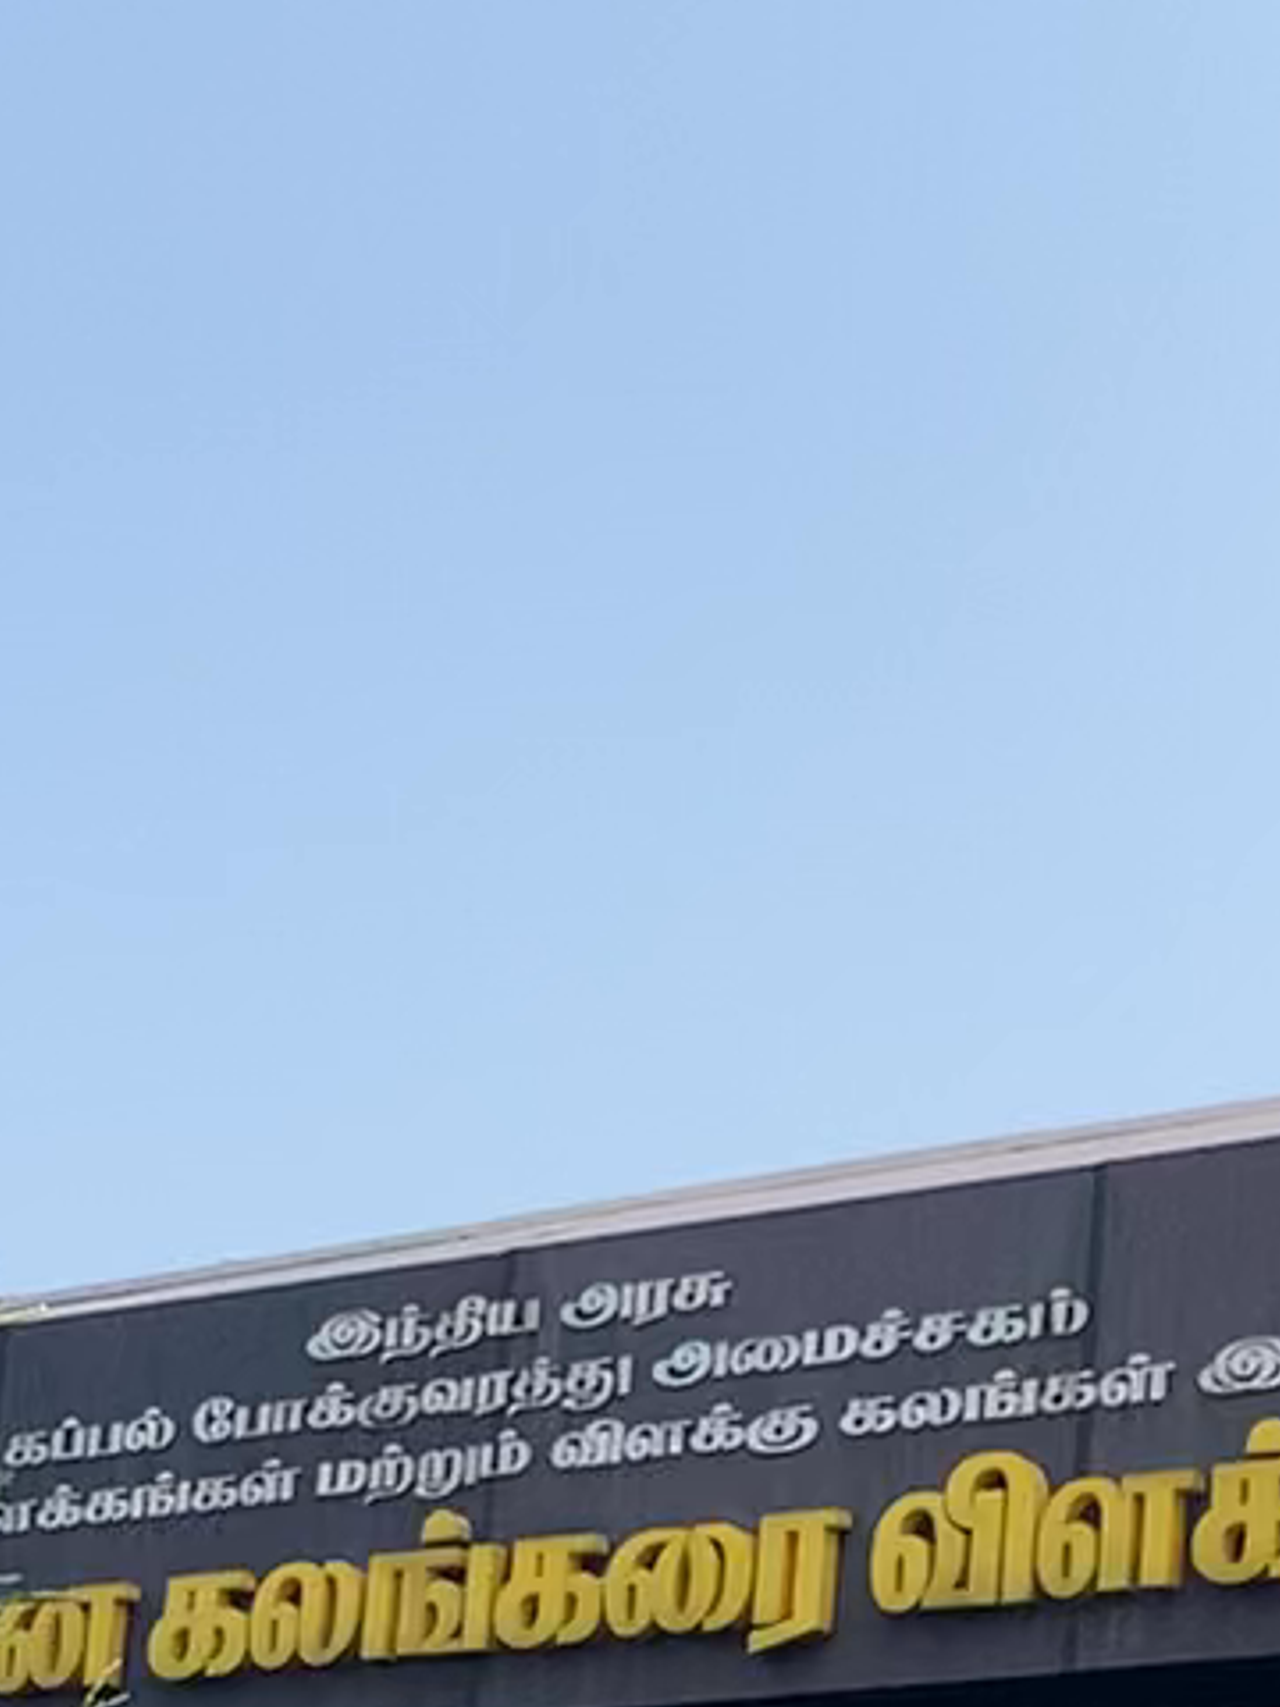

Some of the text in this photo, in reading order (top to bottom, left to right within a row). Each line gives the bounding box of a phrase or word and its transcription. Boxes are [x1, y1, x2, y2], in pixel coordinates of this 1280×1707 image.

[4, 1287, 1089, 1469] கப்பல் போக்குவரத்து அமைச்சகம்
[306, 1270, 732, 1363] இந்திய அரசு
[316, 1429, 531, 1502] மற்றும்
[551, 1401, 818, 1469] விளக்கு
[839, 1352, 1177, 1439] கலங்கள்
[148, 1508, 852, 1682] கலங்கரை
